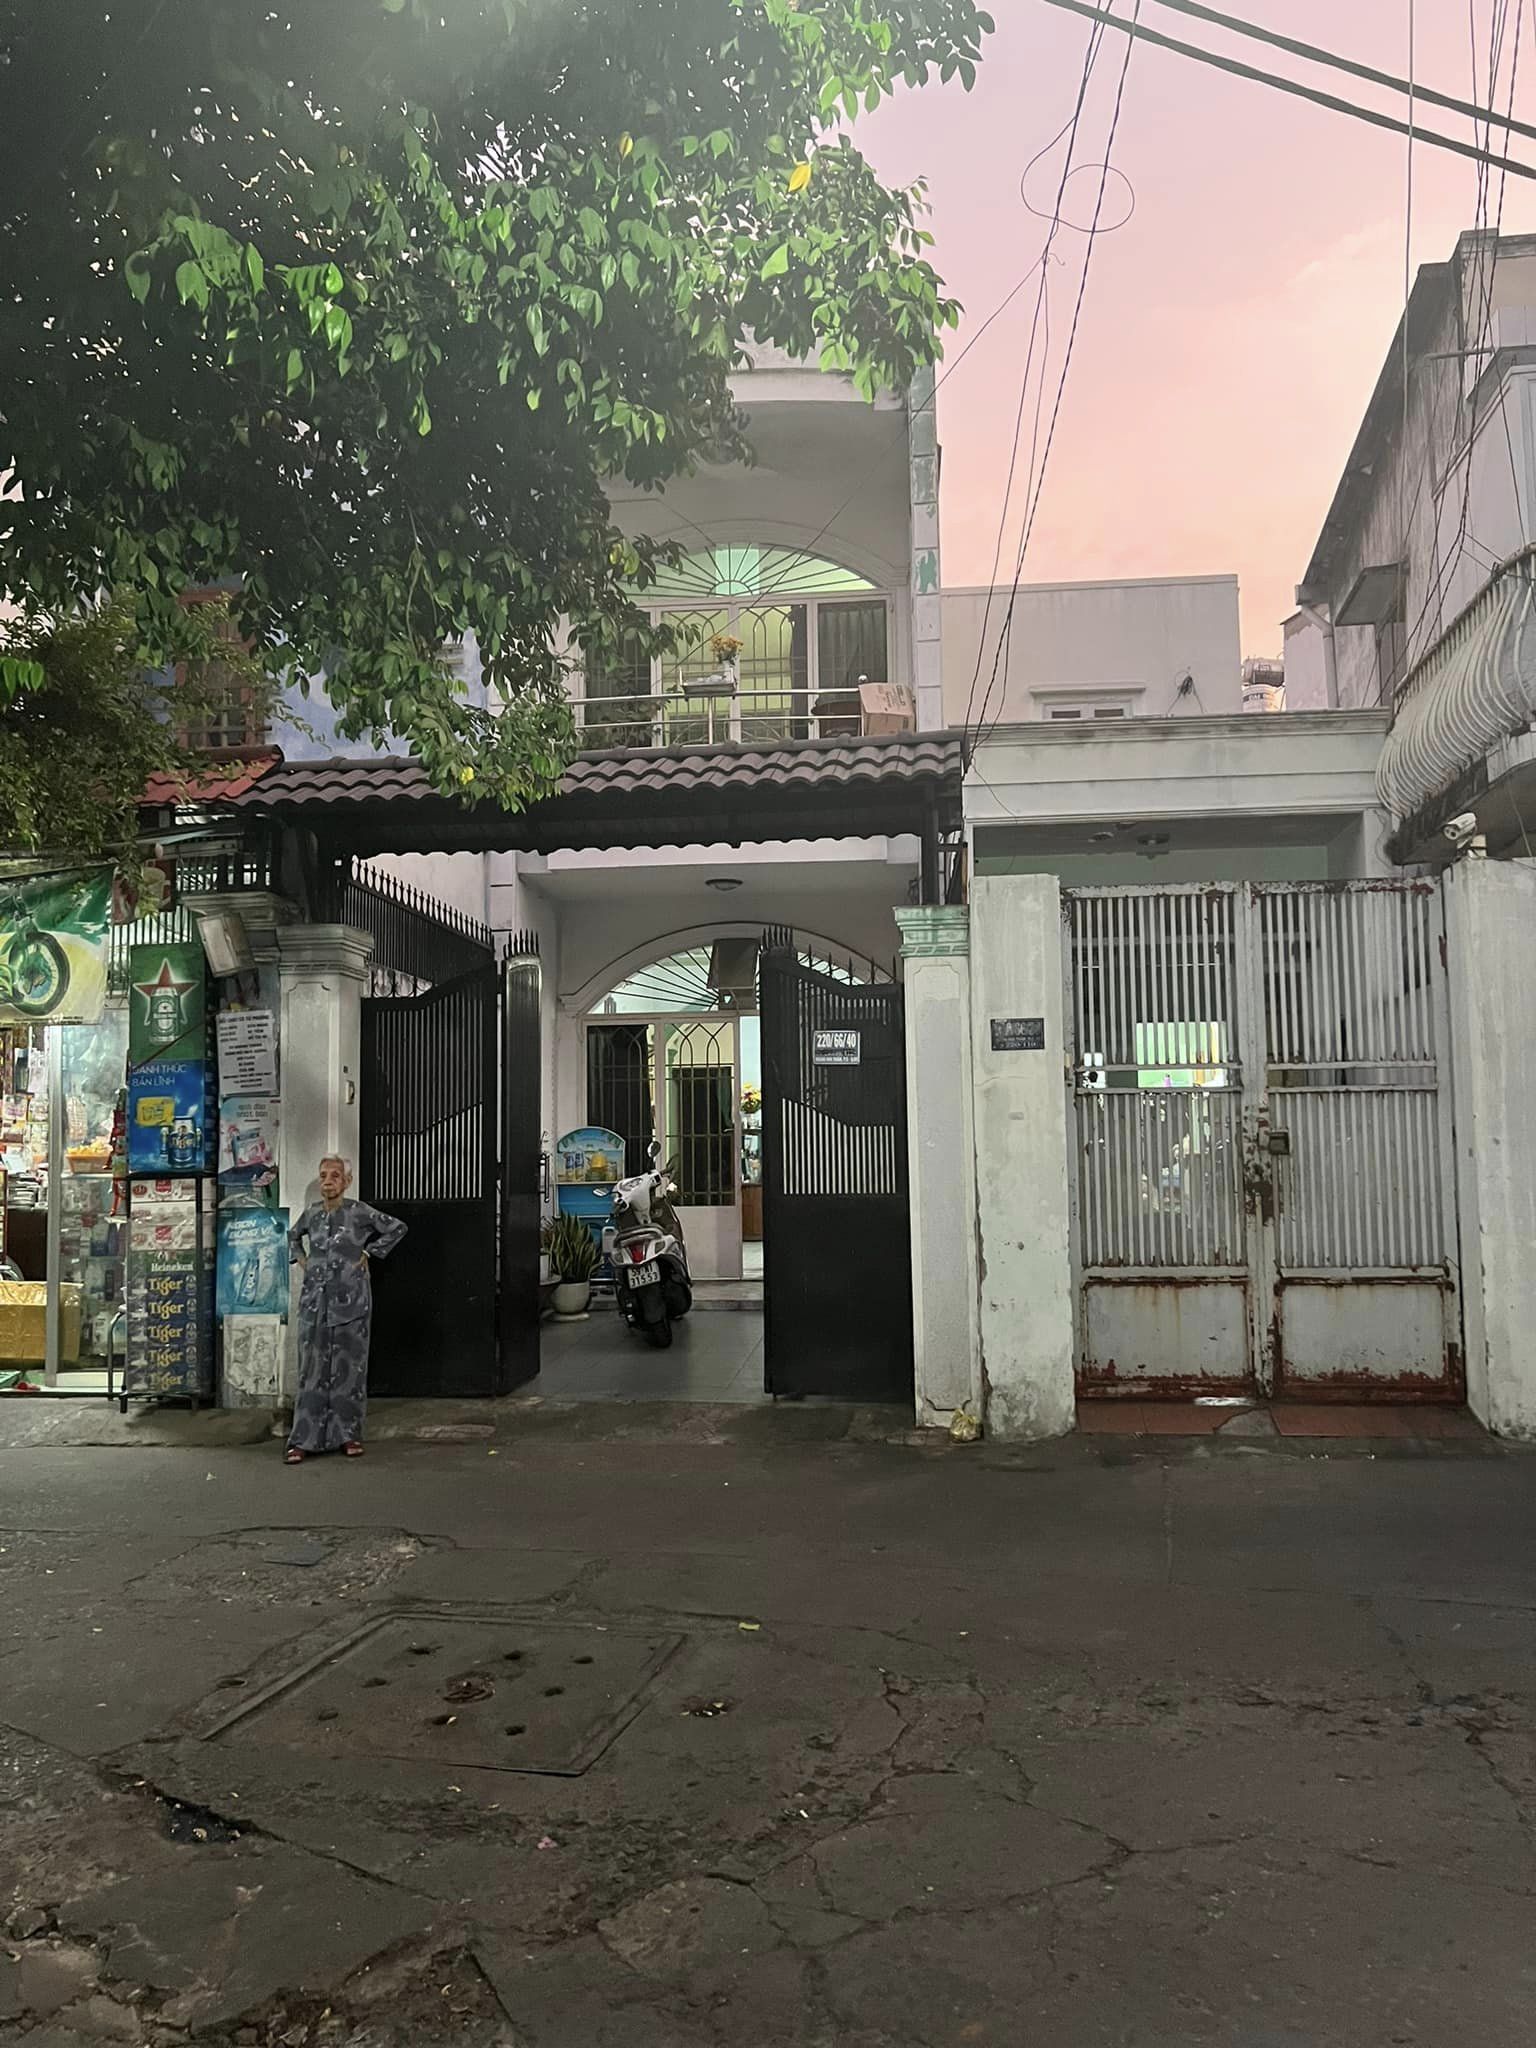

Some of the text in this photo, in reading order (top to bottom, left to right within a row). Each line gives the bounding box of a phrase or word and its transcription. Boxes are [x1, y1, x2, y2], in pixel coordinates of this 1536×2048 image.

[816, 1032, 857, 1048] 220/66/40
[151, 1262, 193, 1272] Heineken
[147, 1276, 183, 1296] Tiger
[148, 1300, 185, 1320] Tiger
[147, 1323, 183, 1343] Tiger
[147, 1347, 183, 1367] Tiger
[149, 1371, 184, 1391] Tiger
